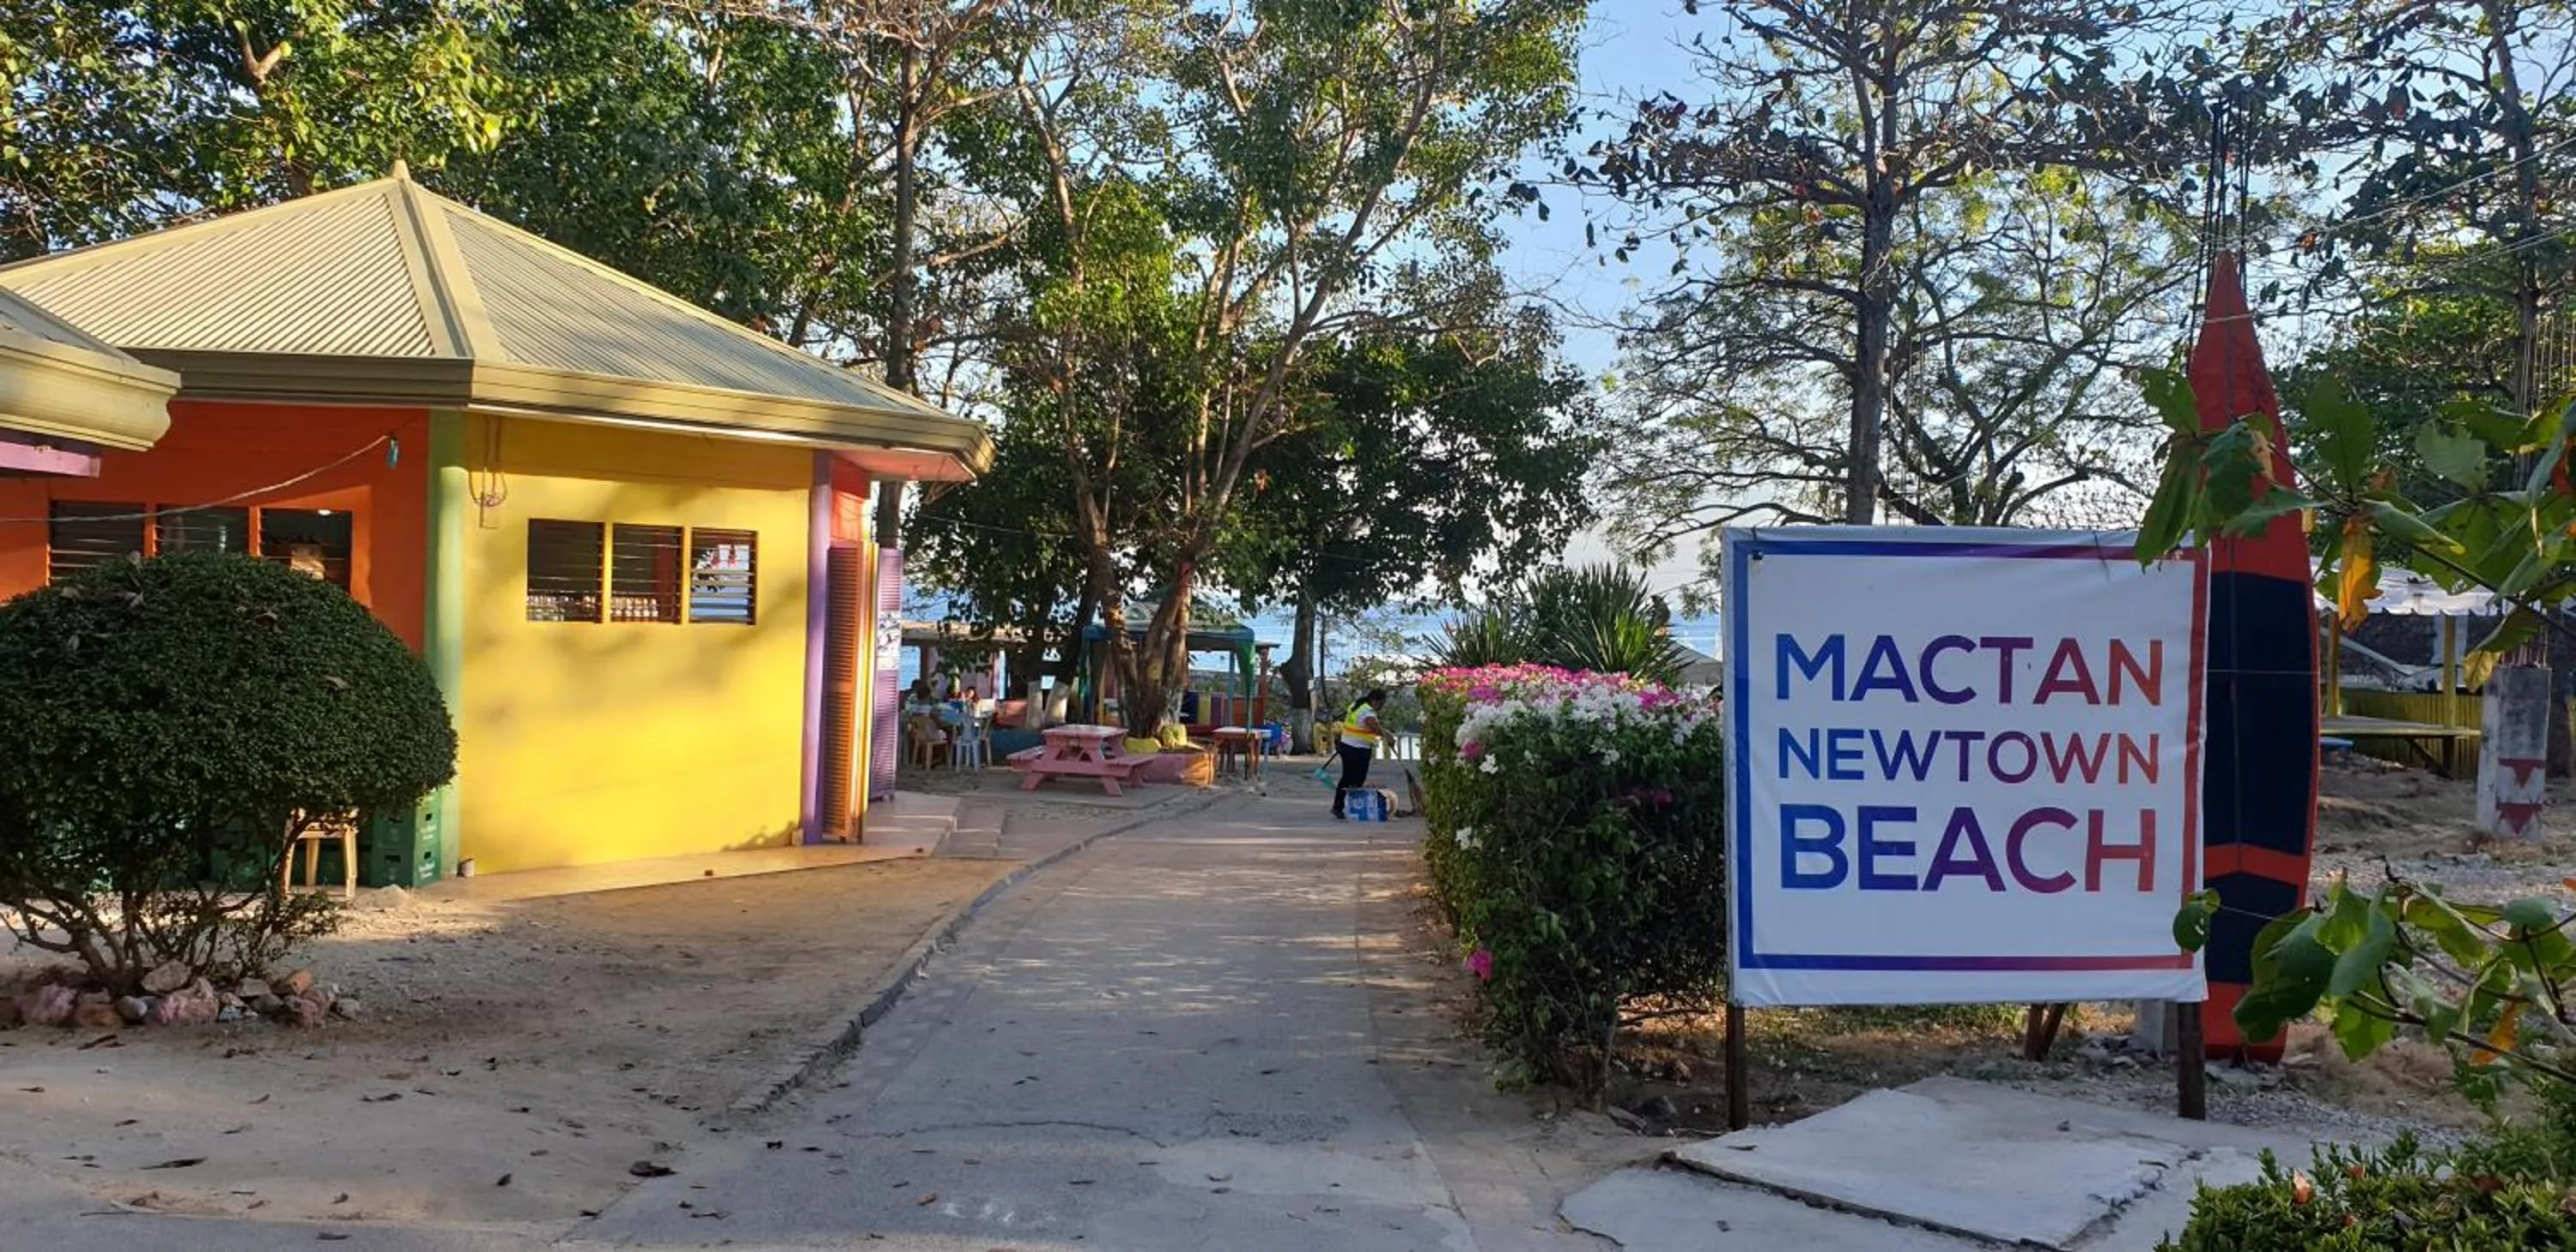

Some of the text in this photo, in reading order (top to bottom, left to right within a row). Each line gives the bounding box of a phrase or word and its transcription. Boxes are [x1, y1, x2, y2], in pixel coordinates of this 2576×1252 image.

[1776, 633, 2162, 706] MACTAN
[1778, 727, 2160, 784] NEWTOWN
[1779, 804, 2156, 894] BEACH
